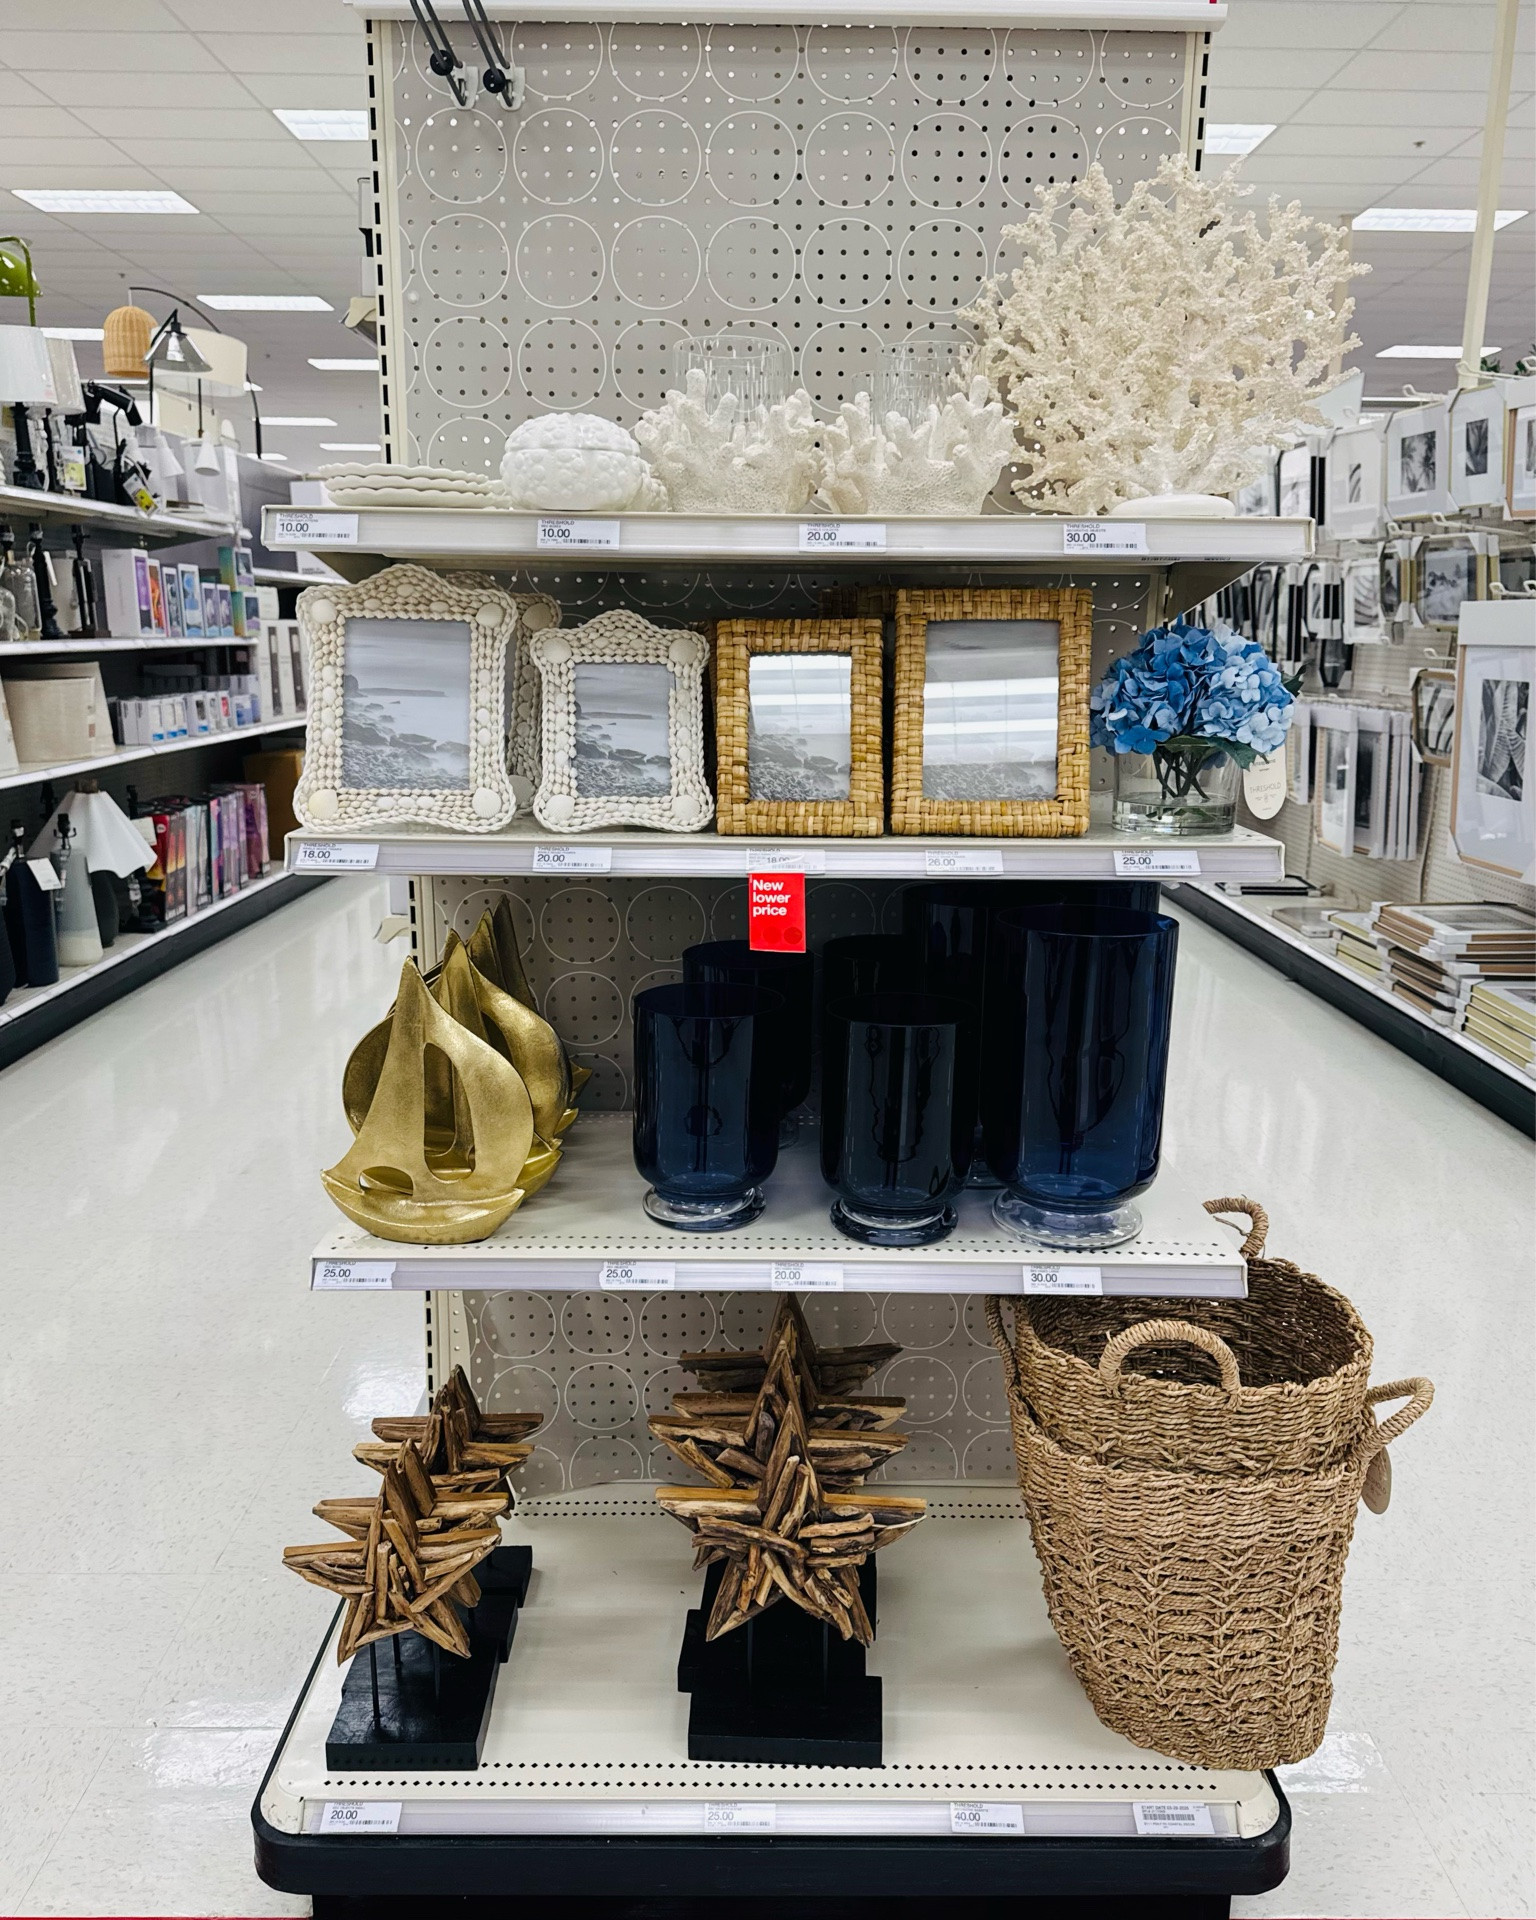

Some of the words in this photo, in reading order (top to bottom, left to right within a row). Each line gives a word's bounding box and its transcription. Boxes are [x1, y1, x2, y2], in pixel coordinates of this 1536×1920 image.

[279, 522, 309, 533] 10.00
[541, 528, 571, 538] 10.00
[807, 532, 837, 541] 20.00
[1066, 532, 1097, 543] 30.00
[1250, 781, 1282, 792] THRESHOLD
[303, 850, 331, 859] 18.00
[537, 853, 566, 863] 20.00
[927, 858, 956, 867] 26.00
[1122, 856, 1152, 865] 25.00
[752, 879, 784, 891] New
[752, 891, 792, 903] lower
[752, 904, 787, 917] price
[323, 1268, 351, 1278] 25.00
[605, 1269, 633, 1279] 25.00
[774, 1270, 801, 1280] 20.00
[1030, 1272, 1058, 1282] 30.00
[330, 1809, 358, 1820] 20.00
[707, 1811, 734, 1821] 25.00
[954, 1811, 981, 1822] 40.00
